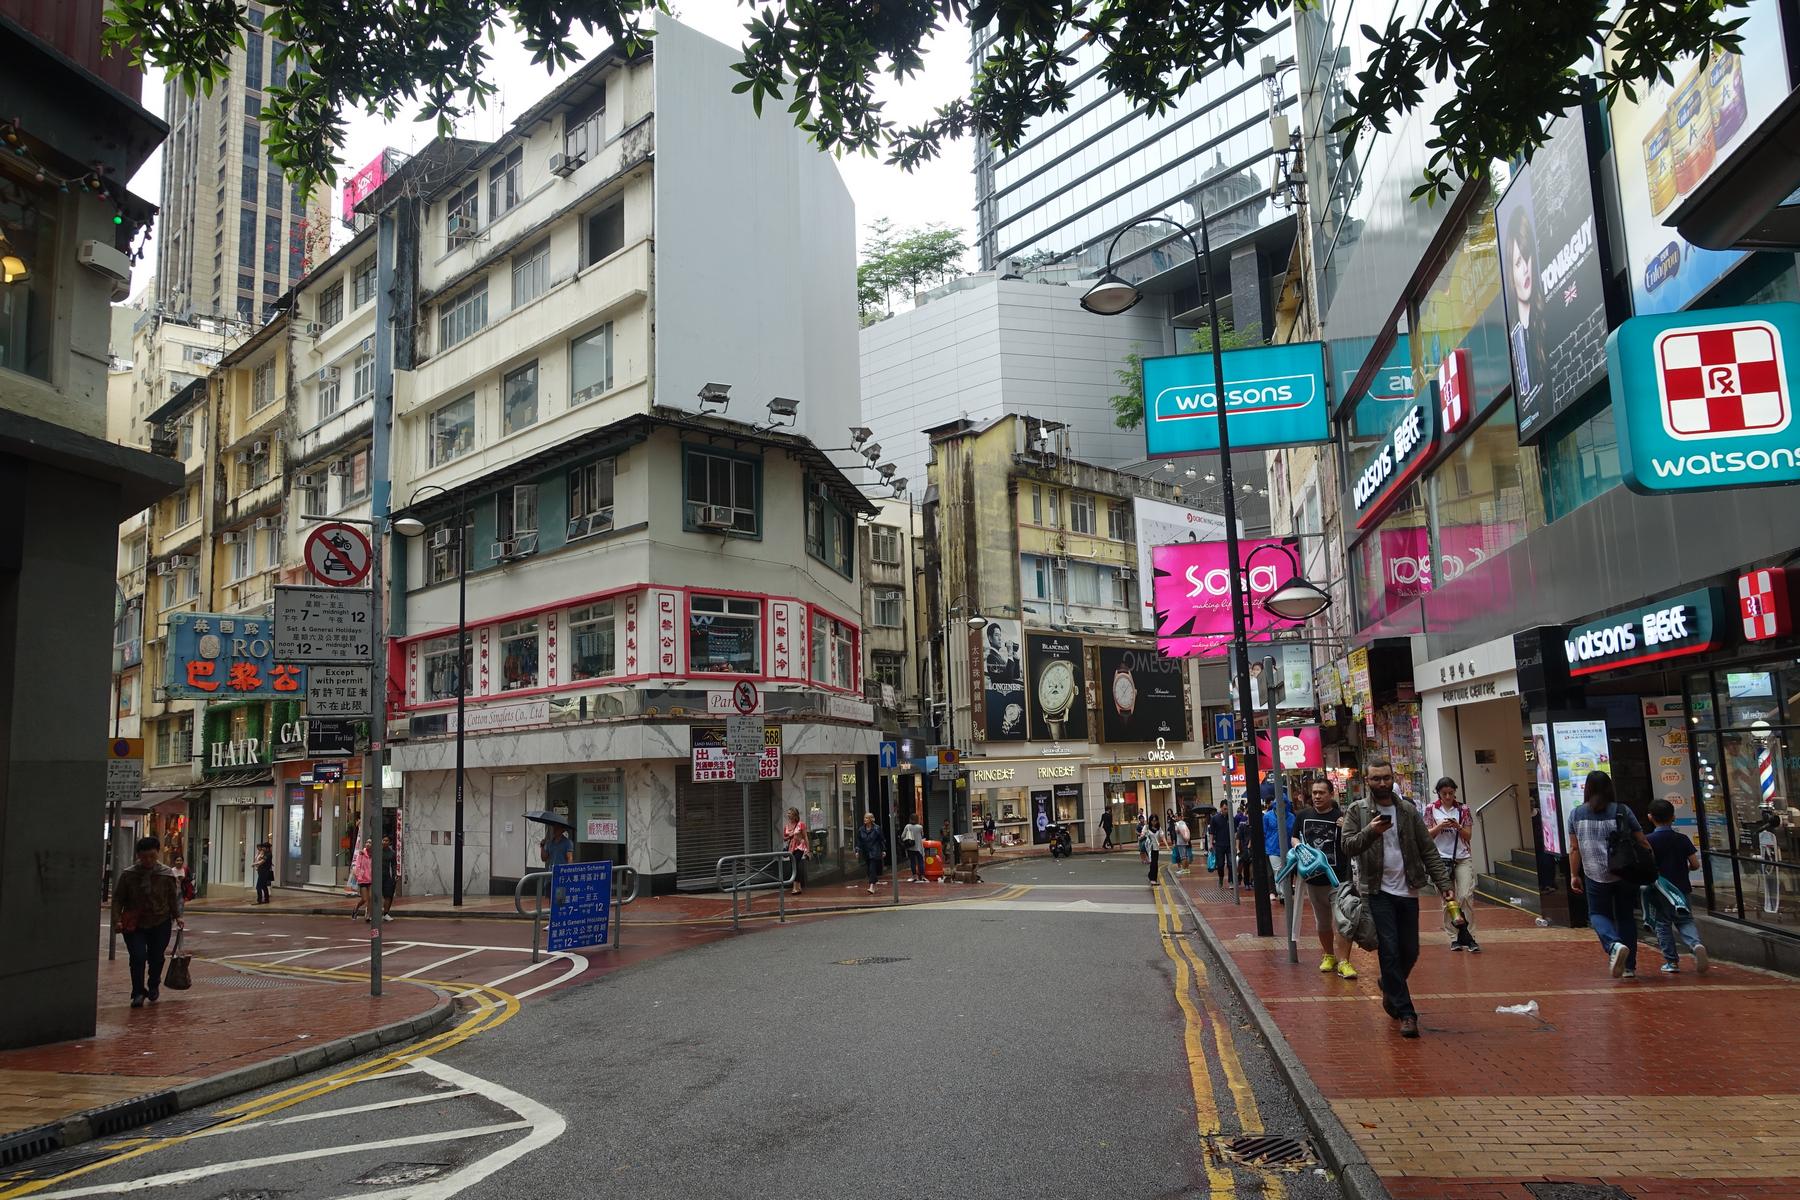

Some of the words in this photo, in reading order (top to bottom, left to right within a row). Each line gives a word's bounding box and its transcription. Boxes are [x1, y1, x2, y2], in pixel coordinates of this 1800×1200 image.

[1176, 385, 1293, 411] wasons
[1651, 447, 1800, 478] watson
[1353, 444, 1392, 510] watsons
[300, 610, 309, 621] 7
[351, 611, 366, 622] 12
[661, 601, 673, 666] 巴黎公司
[775, 610, 788, 670] 巴黎毛冷
[232, 638, 275, 658] RO
[297, 643, 312, 655] 12
[354, 644, 369, 655] 12
[1042, 643, 1070, 651] BLANCPAIN
[1564, 622, 1636, 664] watsons
[1123, 650, 1182, 674] OMEGA
[325, 669, 354, 677] Except
[988, 683, 1021, 691] LONGINES
[1469, 681, 1496, 698] CENTRE
[317, 701, 362, 711] 不在此限
[467, 713, 487, 727] Cotton
[488, 707, 514, 725] Singlets
[211, 738, 259, 768] HAIR
[696, 749, 709, 760] 出
[1148, 751, 1175, 761] OMEGA
[568, 906, 574, 916] 7
[595, 902, 603, 911] 12
[565, 938, 573, 947] 12
[595, 933, 603, 943] 12
